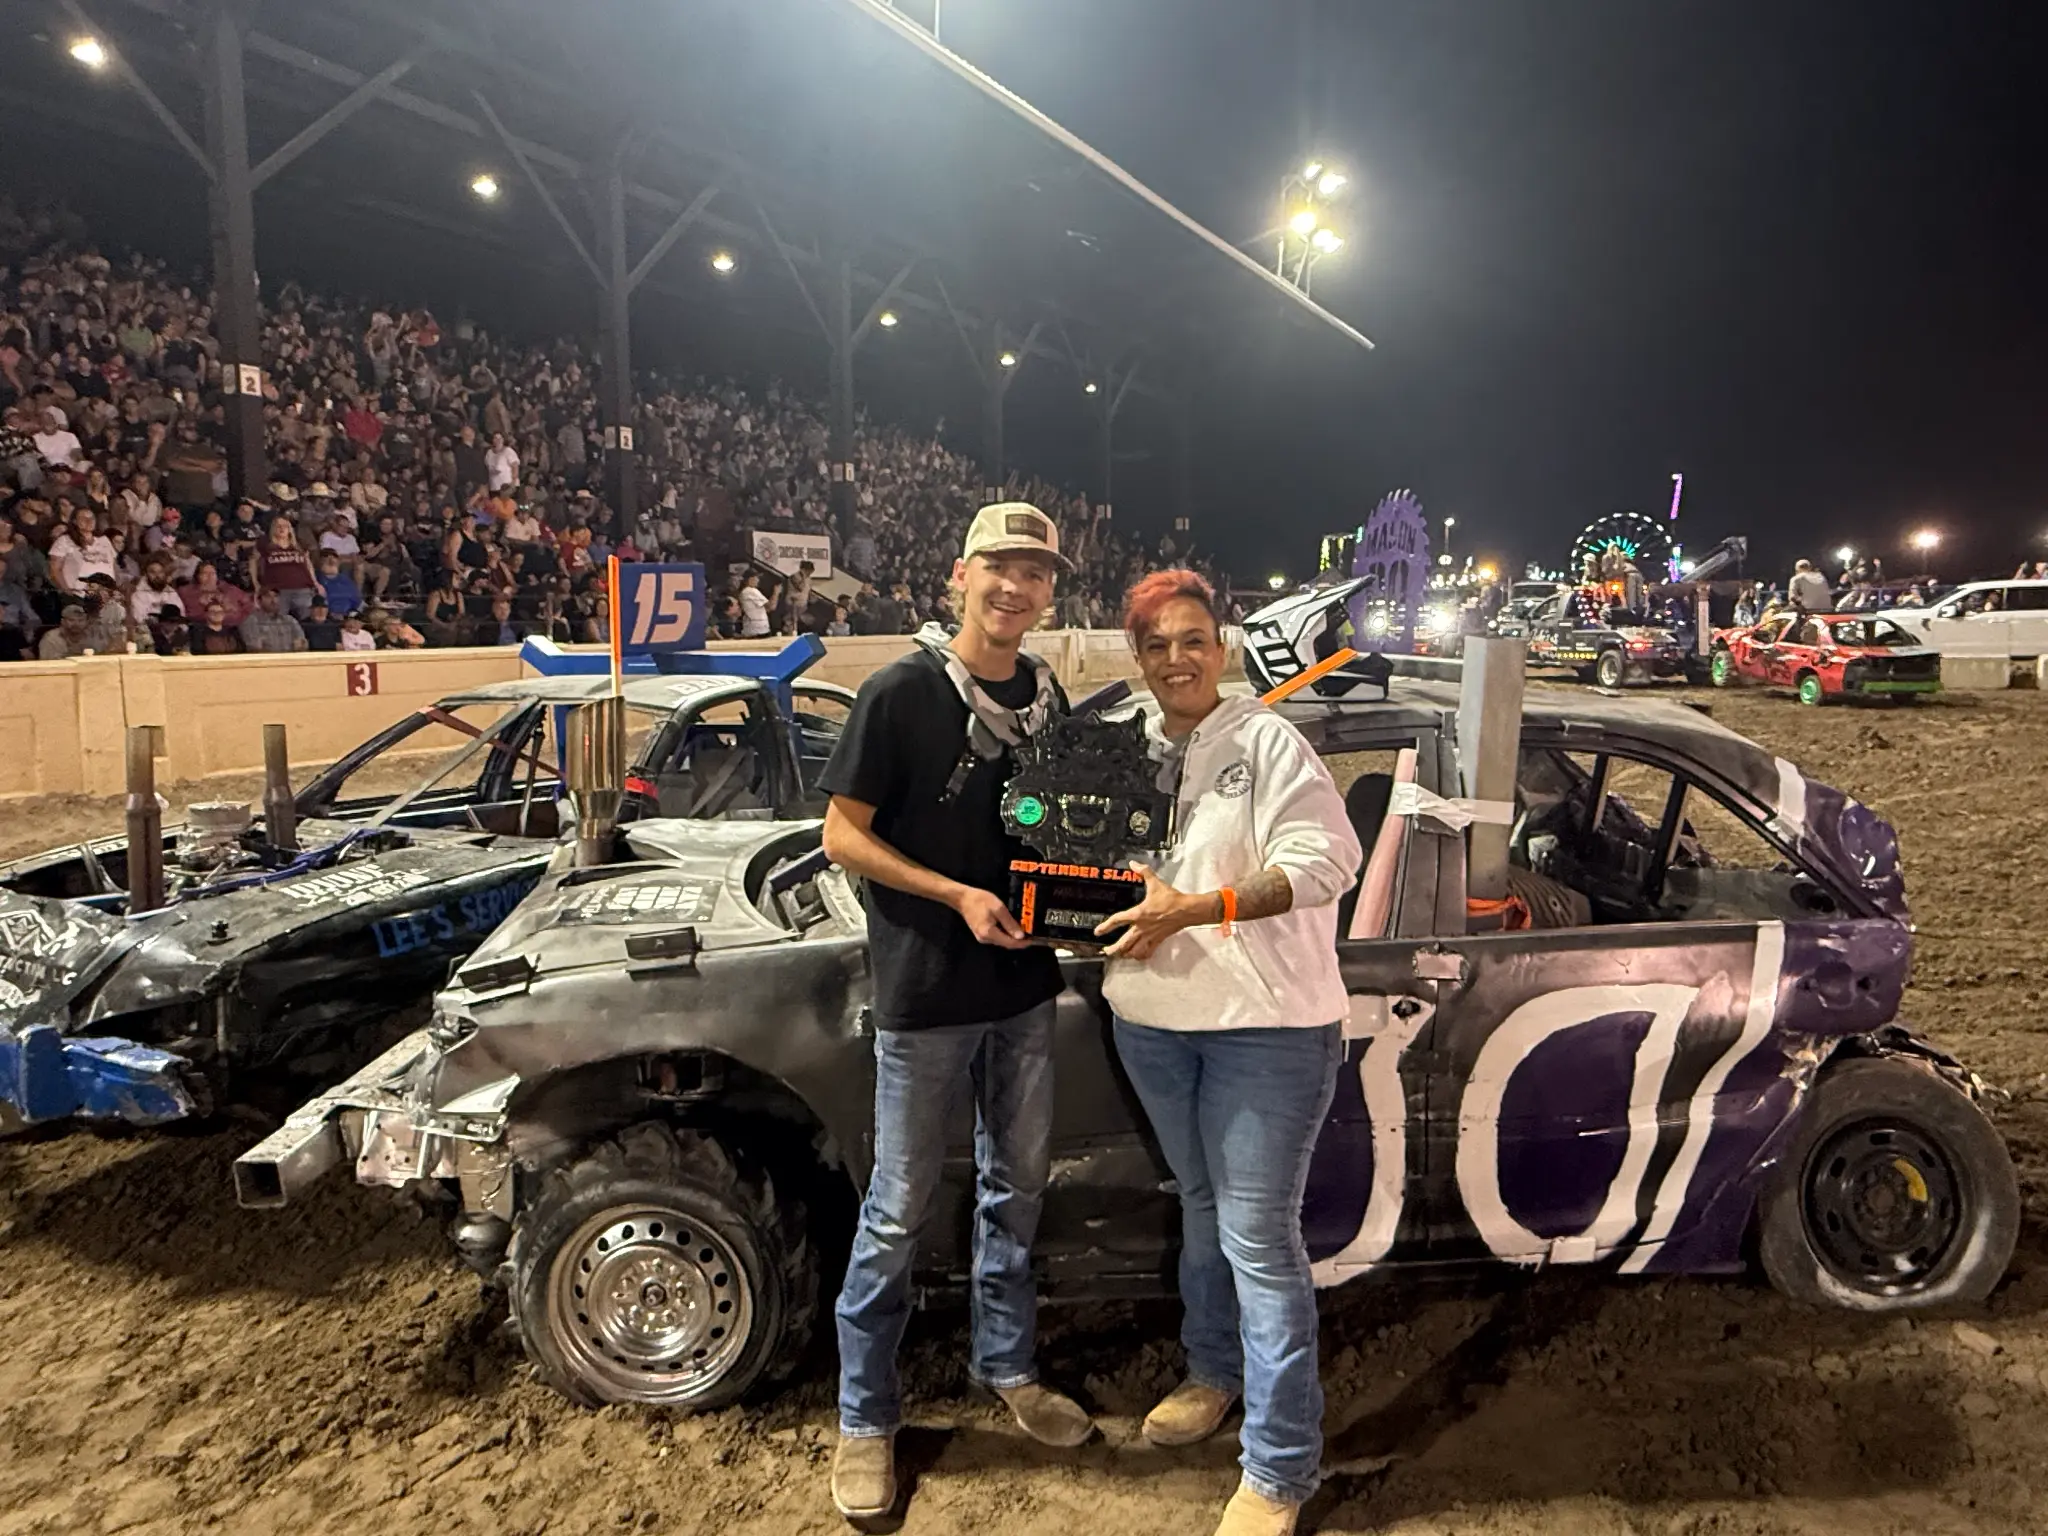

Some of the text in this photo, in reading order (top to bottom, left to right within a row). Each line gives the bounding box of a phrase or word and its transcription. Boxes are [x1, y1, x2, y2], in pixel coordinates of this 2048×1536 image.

[245, 376, 256, 392] 2
[629, 573, 693, 644] 15
[354, 663, 372, 696] 3
[1009, 859, 1100, 879] SEPTEMBER
